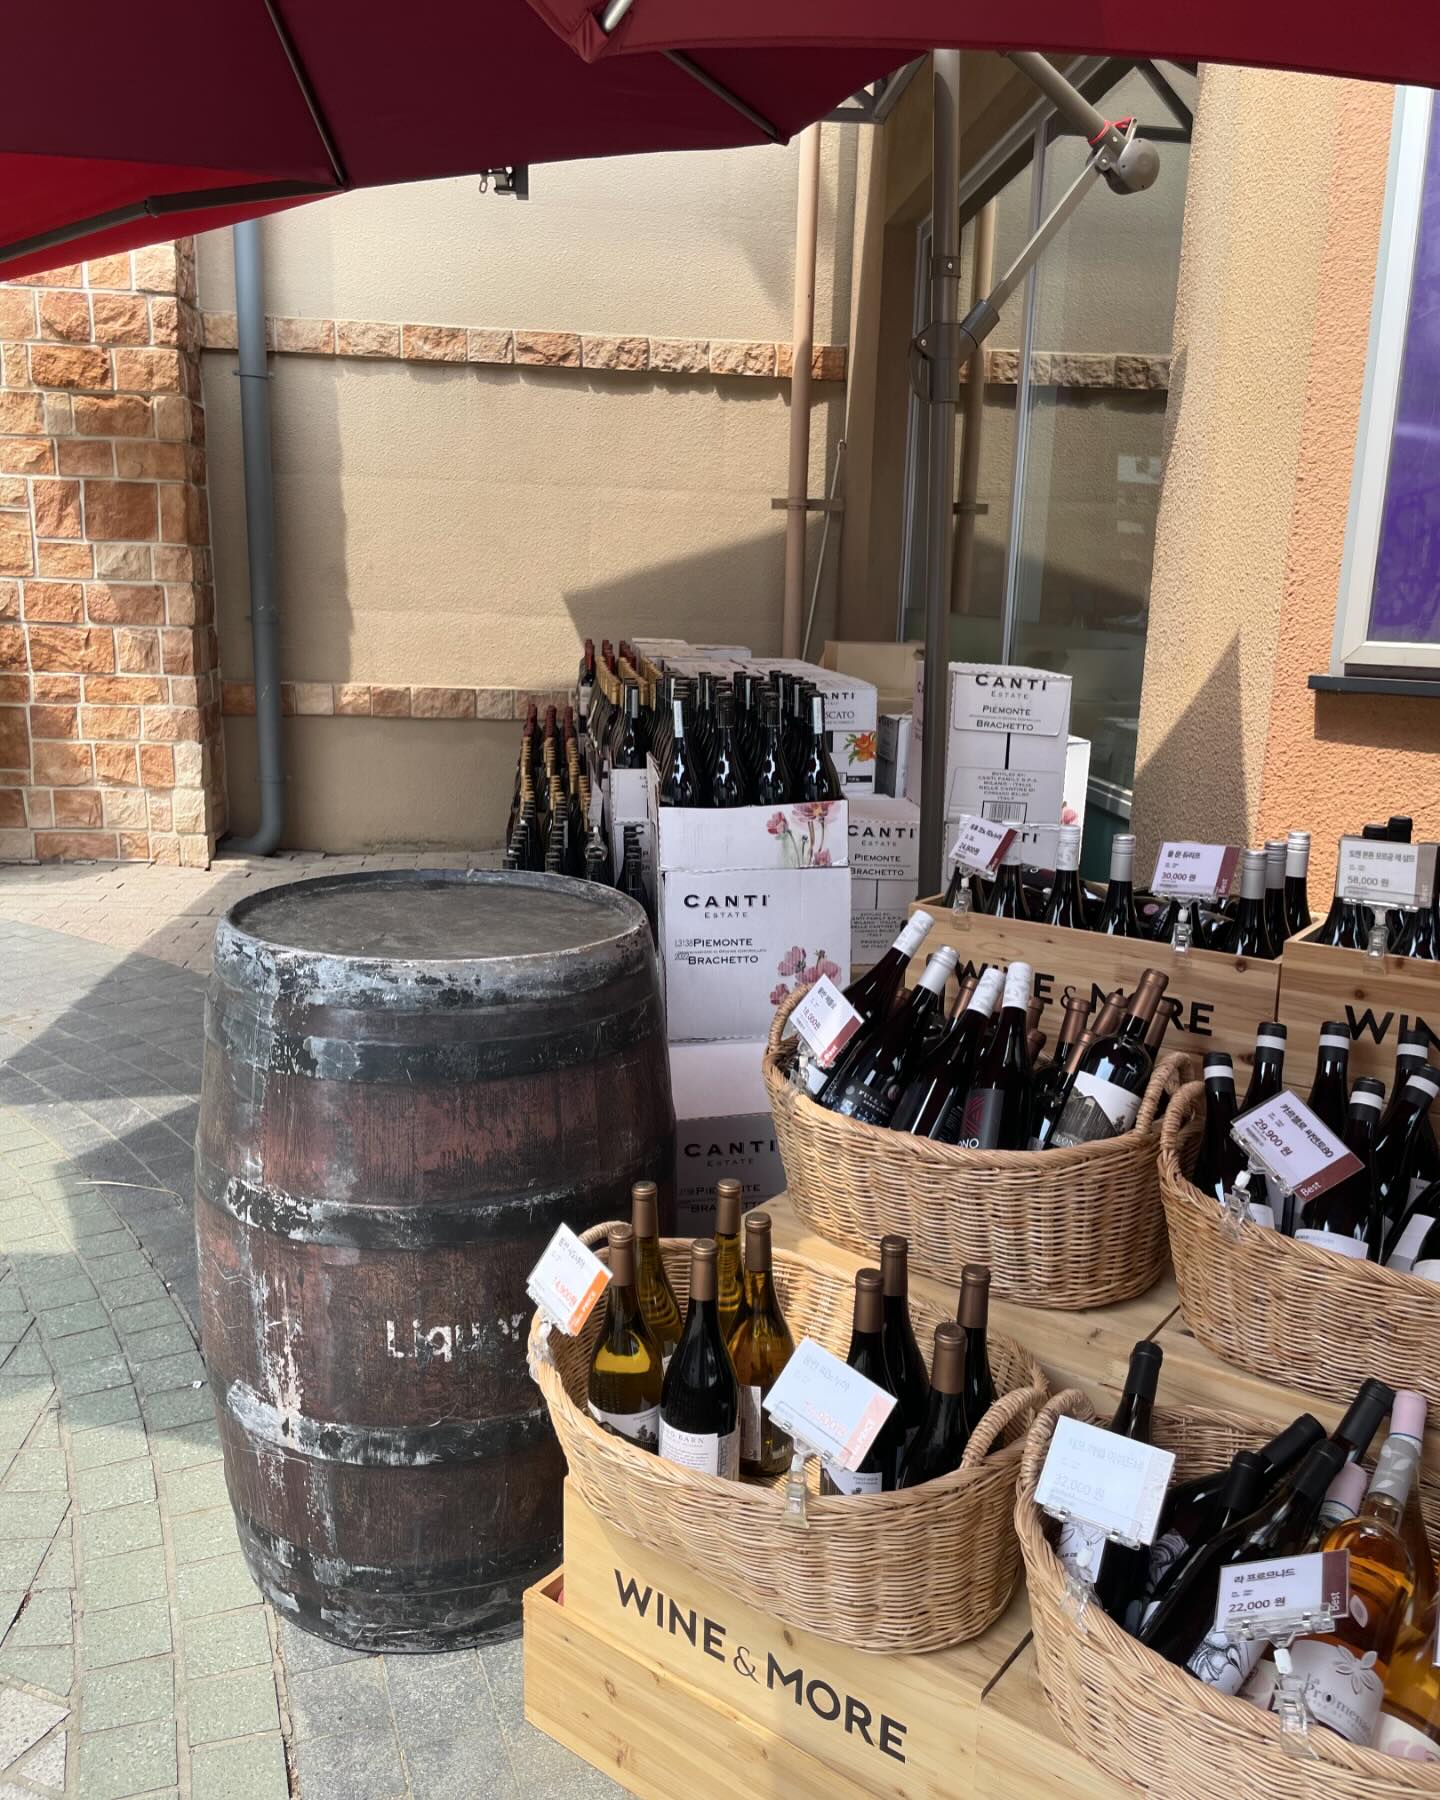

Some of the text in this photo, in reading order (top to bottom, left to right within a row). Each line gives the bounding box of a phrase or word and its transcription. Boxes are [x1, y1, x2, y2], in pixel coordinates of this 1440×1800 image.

[975, 674, 1048, 691] CANTI
[824, 692, 855, 700] ANTI
[991, 690, 1029, 700] ESTATE
[825, 711, 855, 720] SCATO
[982, 705, 1031, 716] PIEMONTE
[976, 720, 1034, 732] BRACHETTO
[848, 825, 914, 839] CANTI
[854, 853, 901, 862] PIEMONTE
[850, 867, 904, 876] BRACHETTO
[1347, 875, 1378, 886] 58,000
[684, 894, 768, 908] CANTI
[693, 938, 753, 948] PIEMONTE
[688, 955, 759, 966] BRACHETTO
[1254, 1118, 1283, 1147] 29,900
[1280, 1147, 1294, 1157] 원
[684, 1140, 776, 1158] CANTI
[1300, 1182, 1321, 1197] Best
[1228, 1597, 1286, 1613] 22,000 원
[1330, 1592, 1340, 1611] Best
